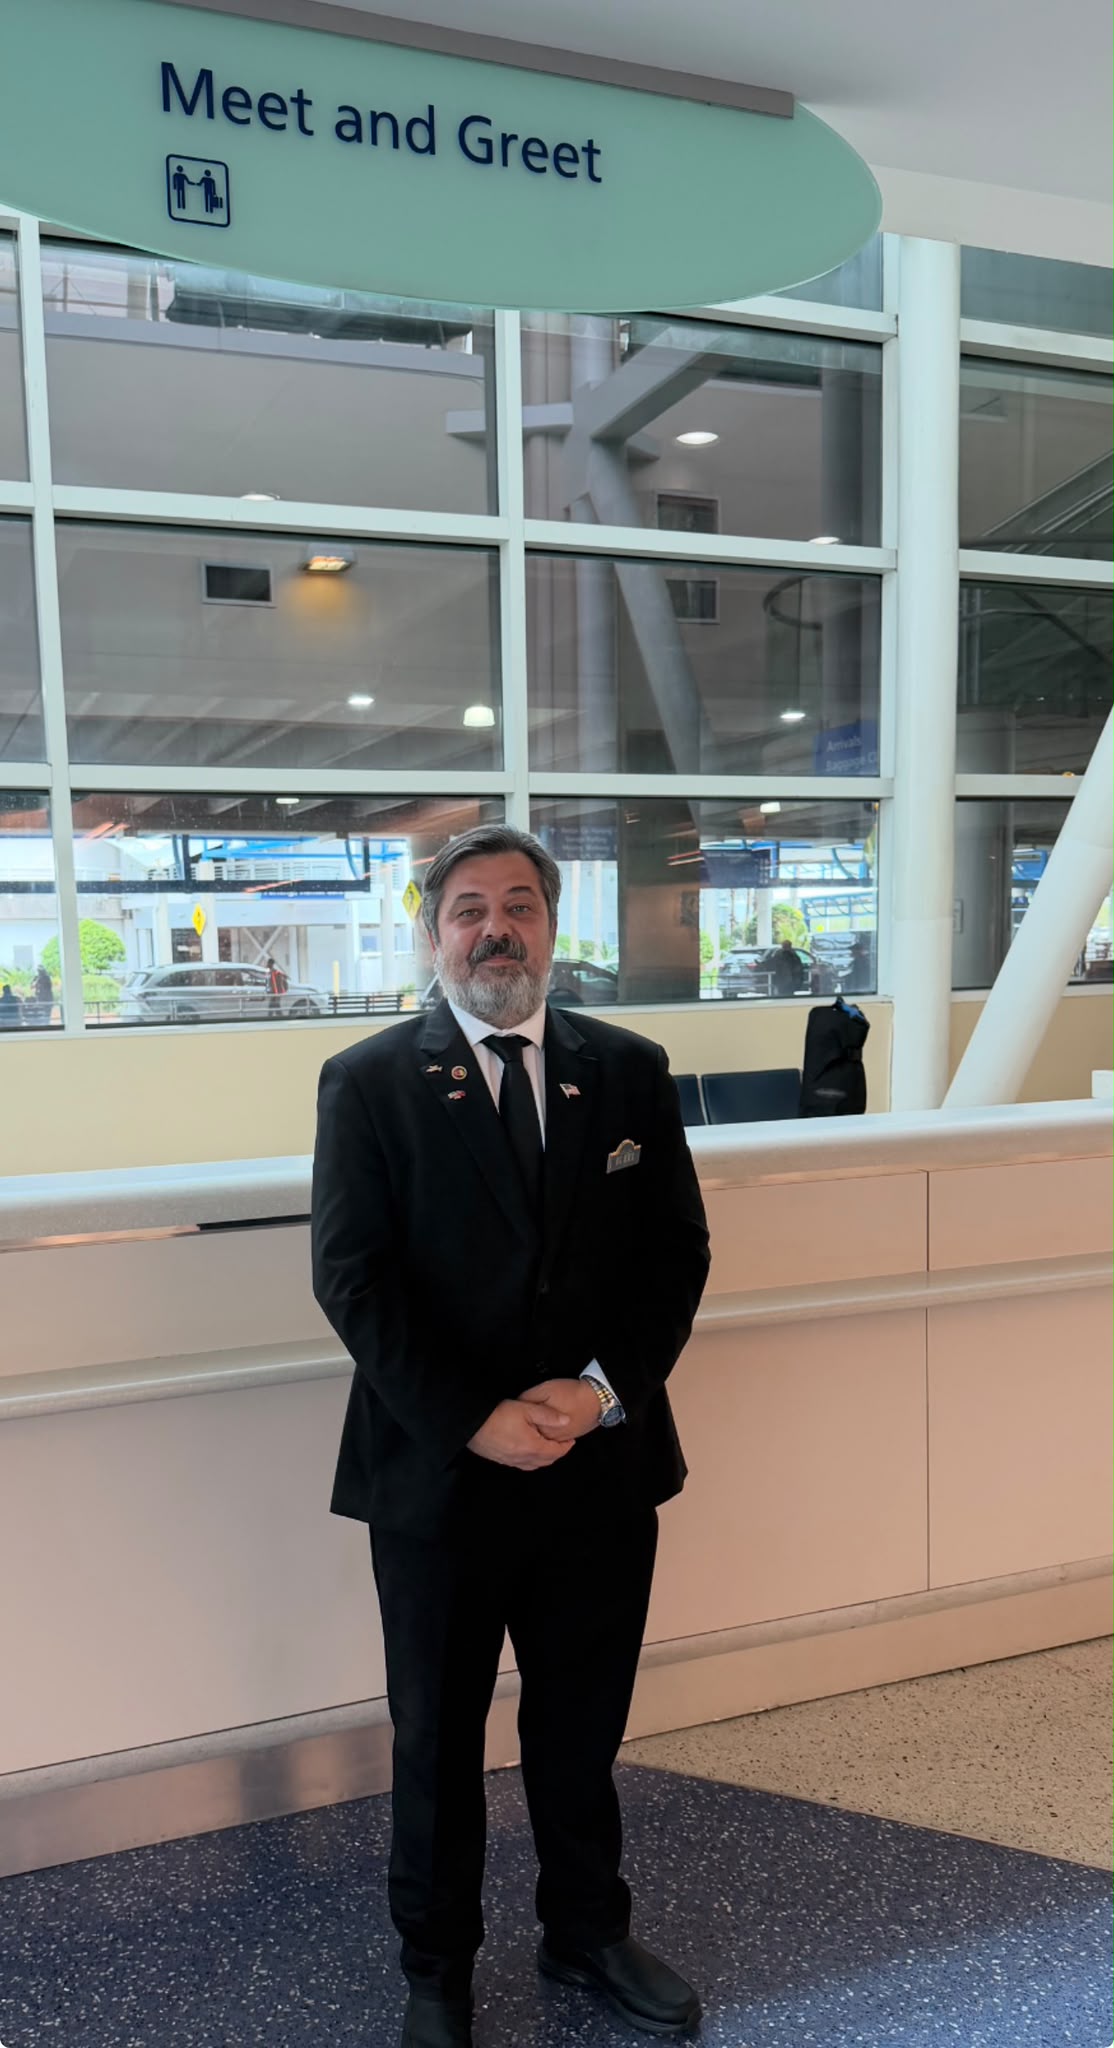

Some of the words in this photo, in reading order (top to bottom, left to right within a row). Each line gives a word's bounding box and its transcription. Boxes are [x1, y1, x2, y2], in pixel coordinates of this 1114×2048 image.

[160, 61, 315, 137] Meet
[334, 103, 437, 156] and
[457, 114, 603, 184] Greet
